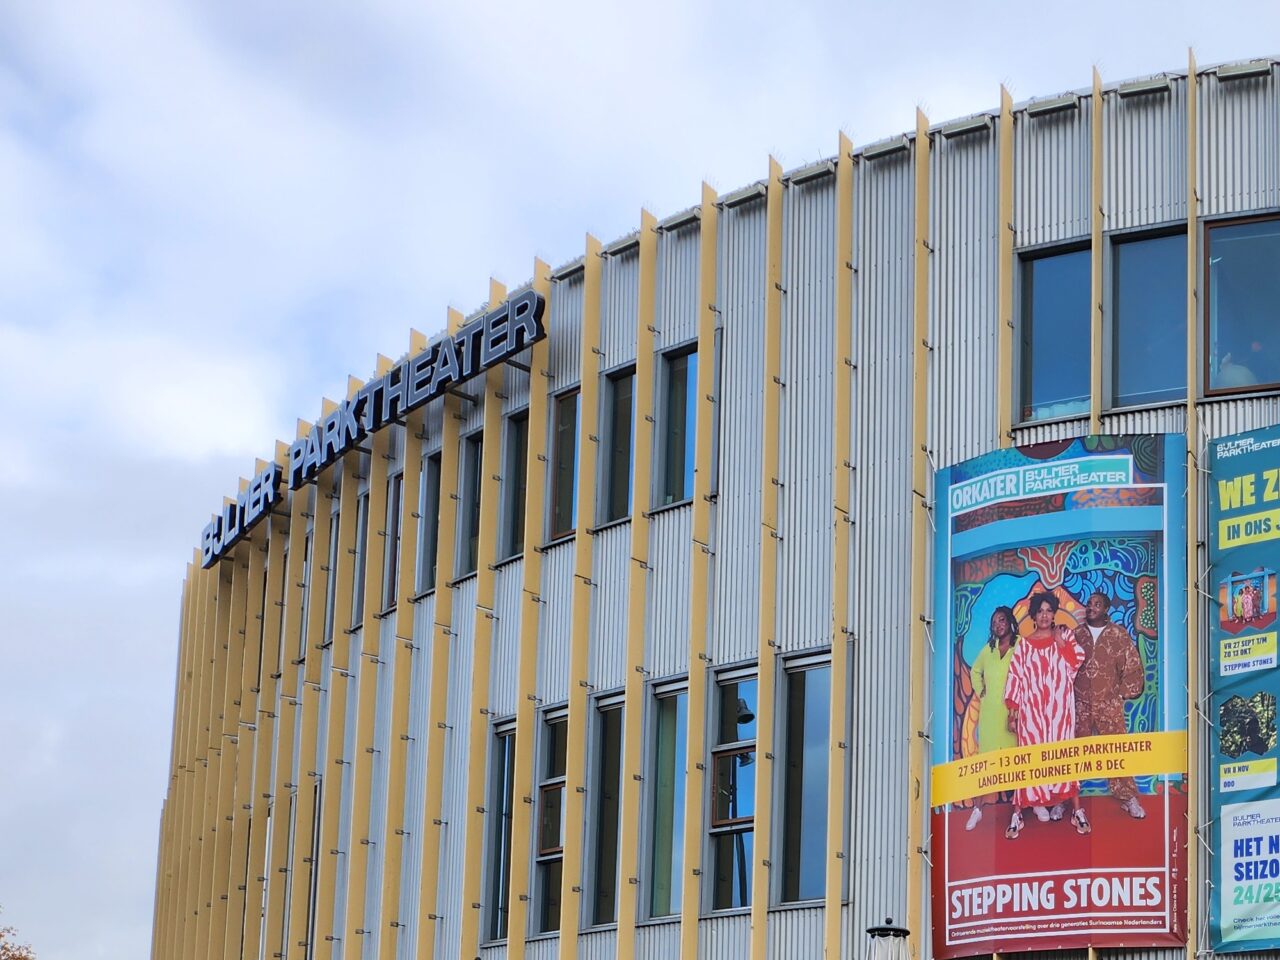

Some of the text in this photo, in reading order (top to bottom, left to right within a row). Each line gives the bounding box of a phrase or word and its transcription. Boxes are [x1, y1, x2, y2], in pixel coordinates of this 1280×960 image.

[289, 288, 546, 490] PARKTHEATER
[953, 474, 1017, 509] ORKATER
[1026, 472, 1126, 492] PARKTHEATER
[1218, 474, 1256, 511] WE
[1227, 524, 1240, 541] IN
[1244, 518, 1271, 536] ONS
[1224, 642, 1232, 650] VR
[1241, 639, 1255, 647] SEPT
[1240, 648, 1251, 656] OKT
[1224, 658, 1273, 671] STEPPING STONES
[958, 766, 968, 777] 27
[970, 760, 988, 775] SEPT
[999, 756, 1010, 768] 13
[1013, 753, 1032, 766] OKT
[1041, 746, 1080, 762] BIJLMER
[1083, 741, 1152, 756] PARKTHEATER
[978, 759, 1125, 789] LANDELIJKE TOURNEE T/M 8 DEC
[1234, 836, 1263, 858] HET
[951, 877, 1162, 919] STEPPING STONES
[1061, 920, 1088, 928] generaties
